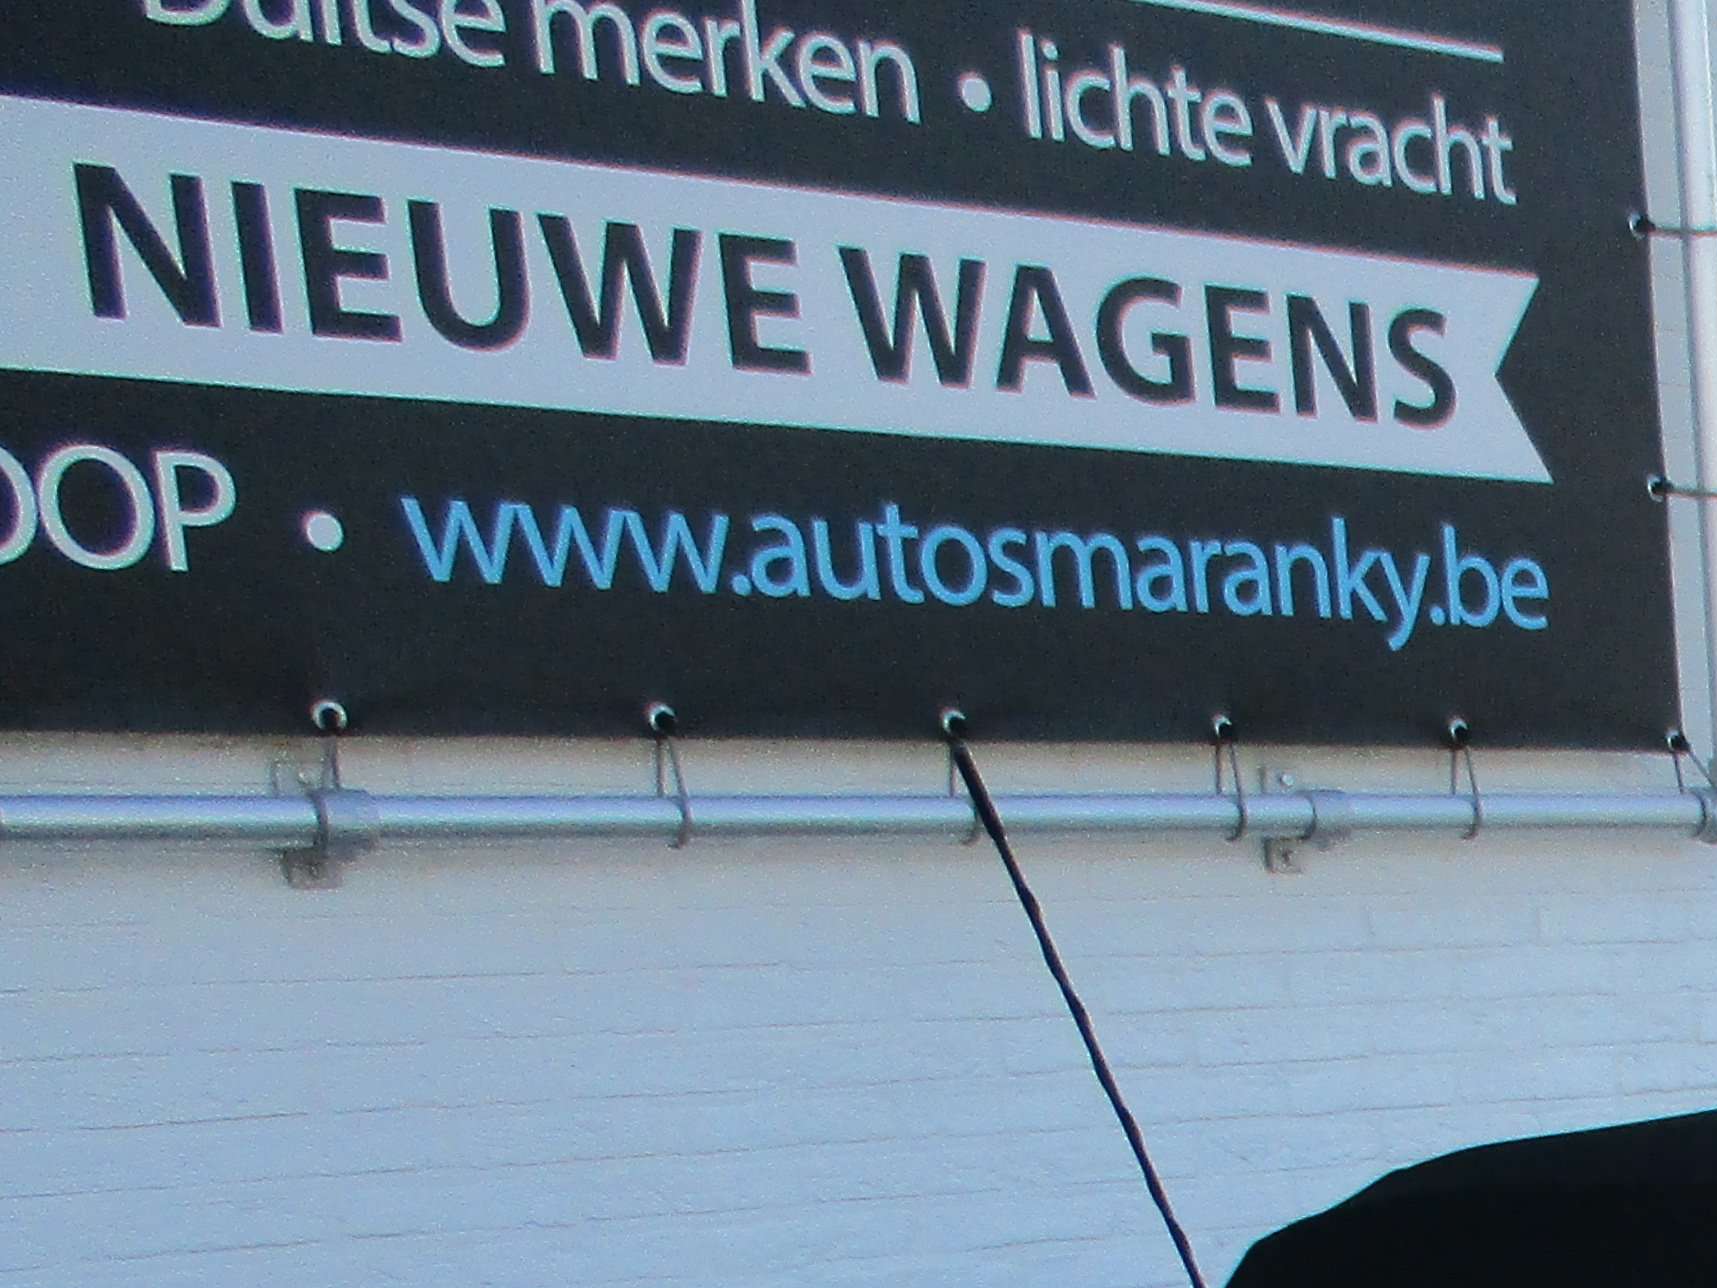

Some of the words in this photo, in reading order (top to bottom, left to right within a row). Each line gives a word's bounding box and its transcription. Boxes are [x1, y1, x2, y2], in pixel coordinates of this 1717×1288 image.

[534, 0, 922, 124] merken
[1016, 27, 1253, 168] lichte
[1267, 92, 1518, 206] vracht
[72, 161, 813, 376] NIEUWE
[836, 245, 1459, 430] WAGENS
[401, 497, 1550, 651] www.autosmaranky.be
